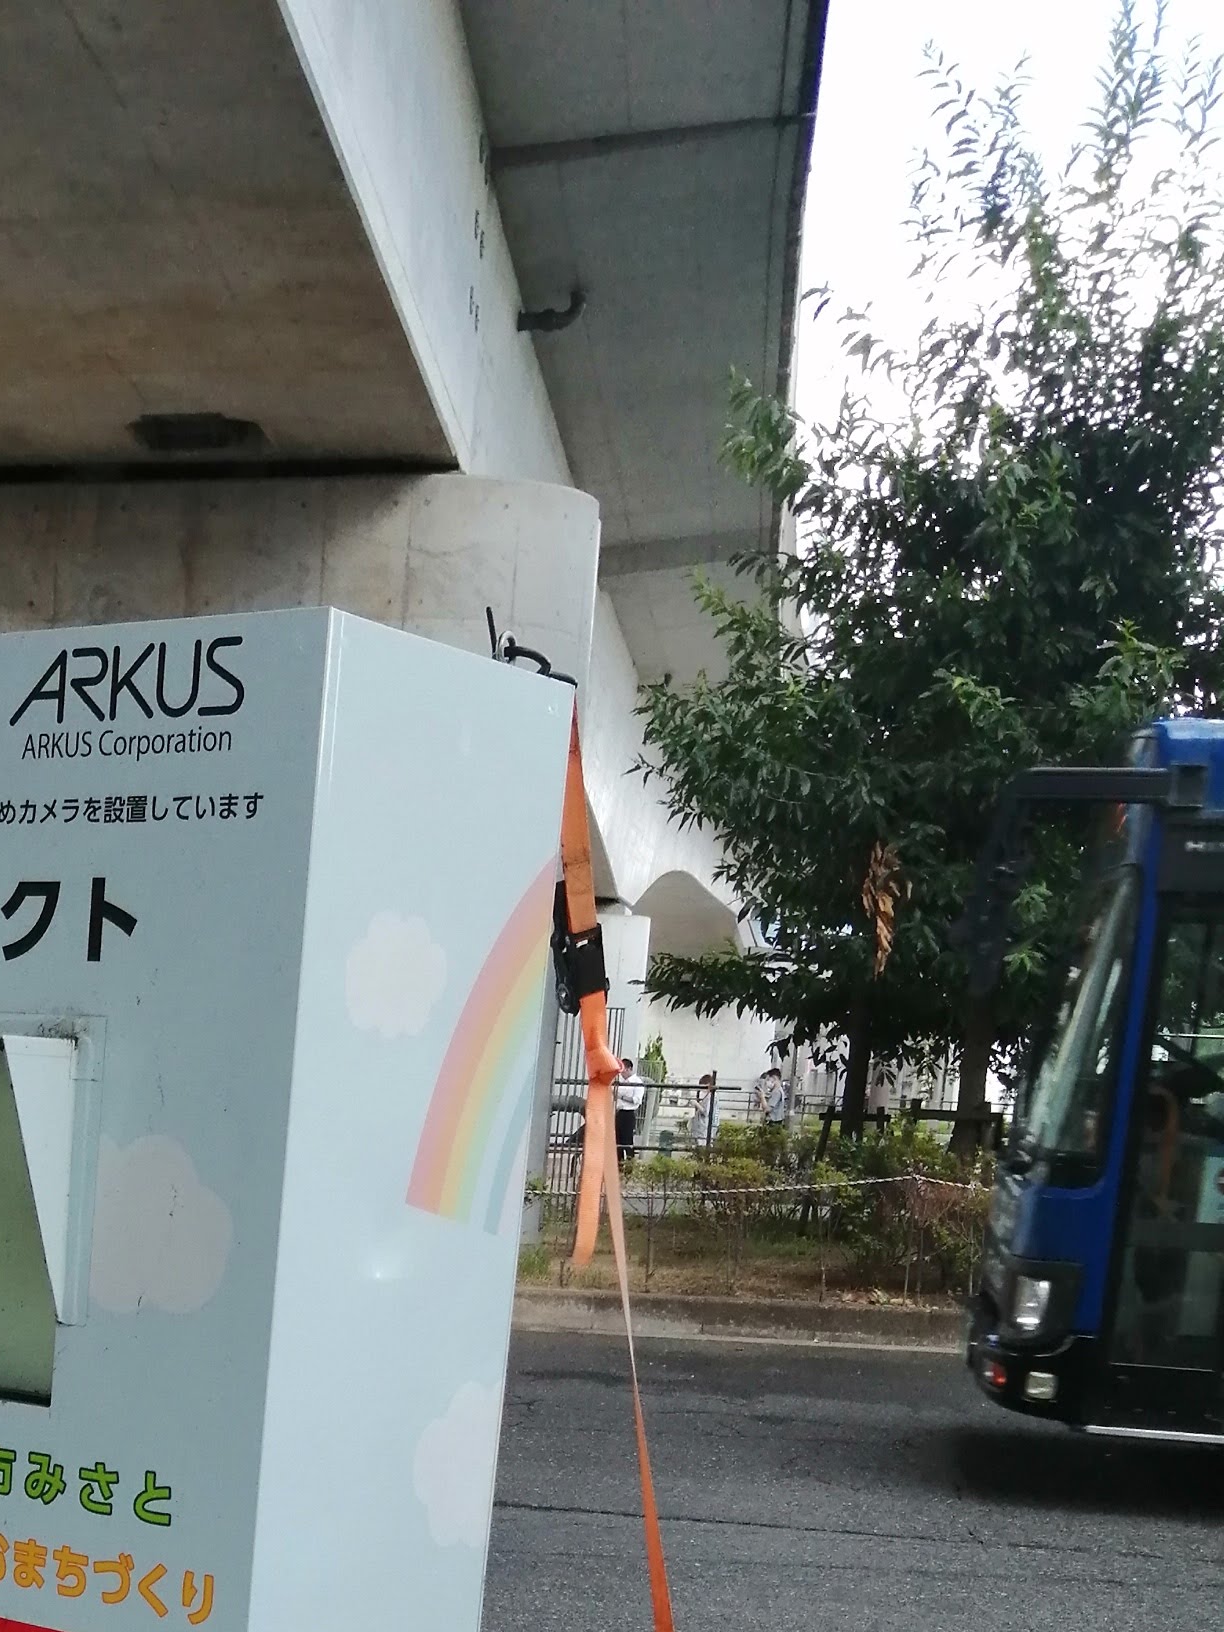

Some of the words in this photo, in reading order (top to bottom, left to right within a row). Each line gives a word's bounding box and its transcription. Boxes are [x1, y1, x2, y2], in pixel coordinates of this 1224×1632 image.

[9, 636, 245, 727] ARKUS
[21, 731, 92, 760] ARKUS
[98, 725, 233, 762] Corporation
